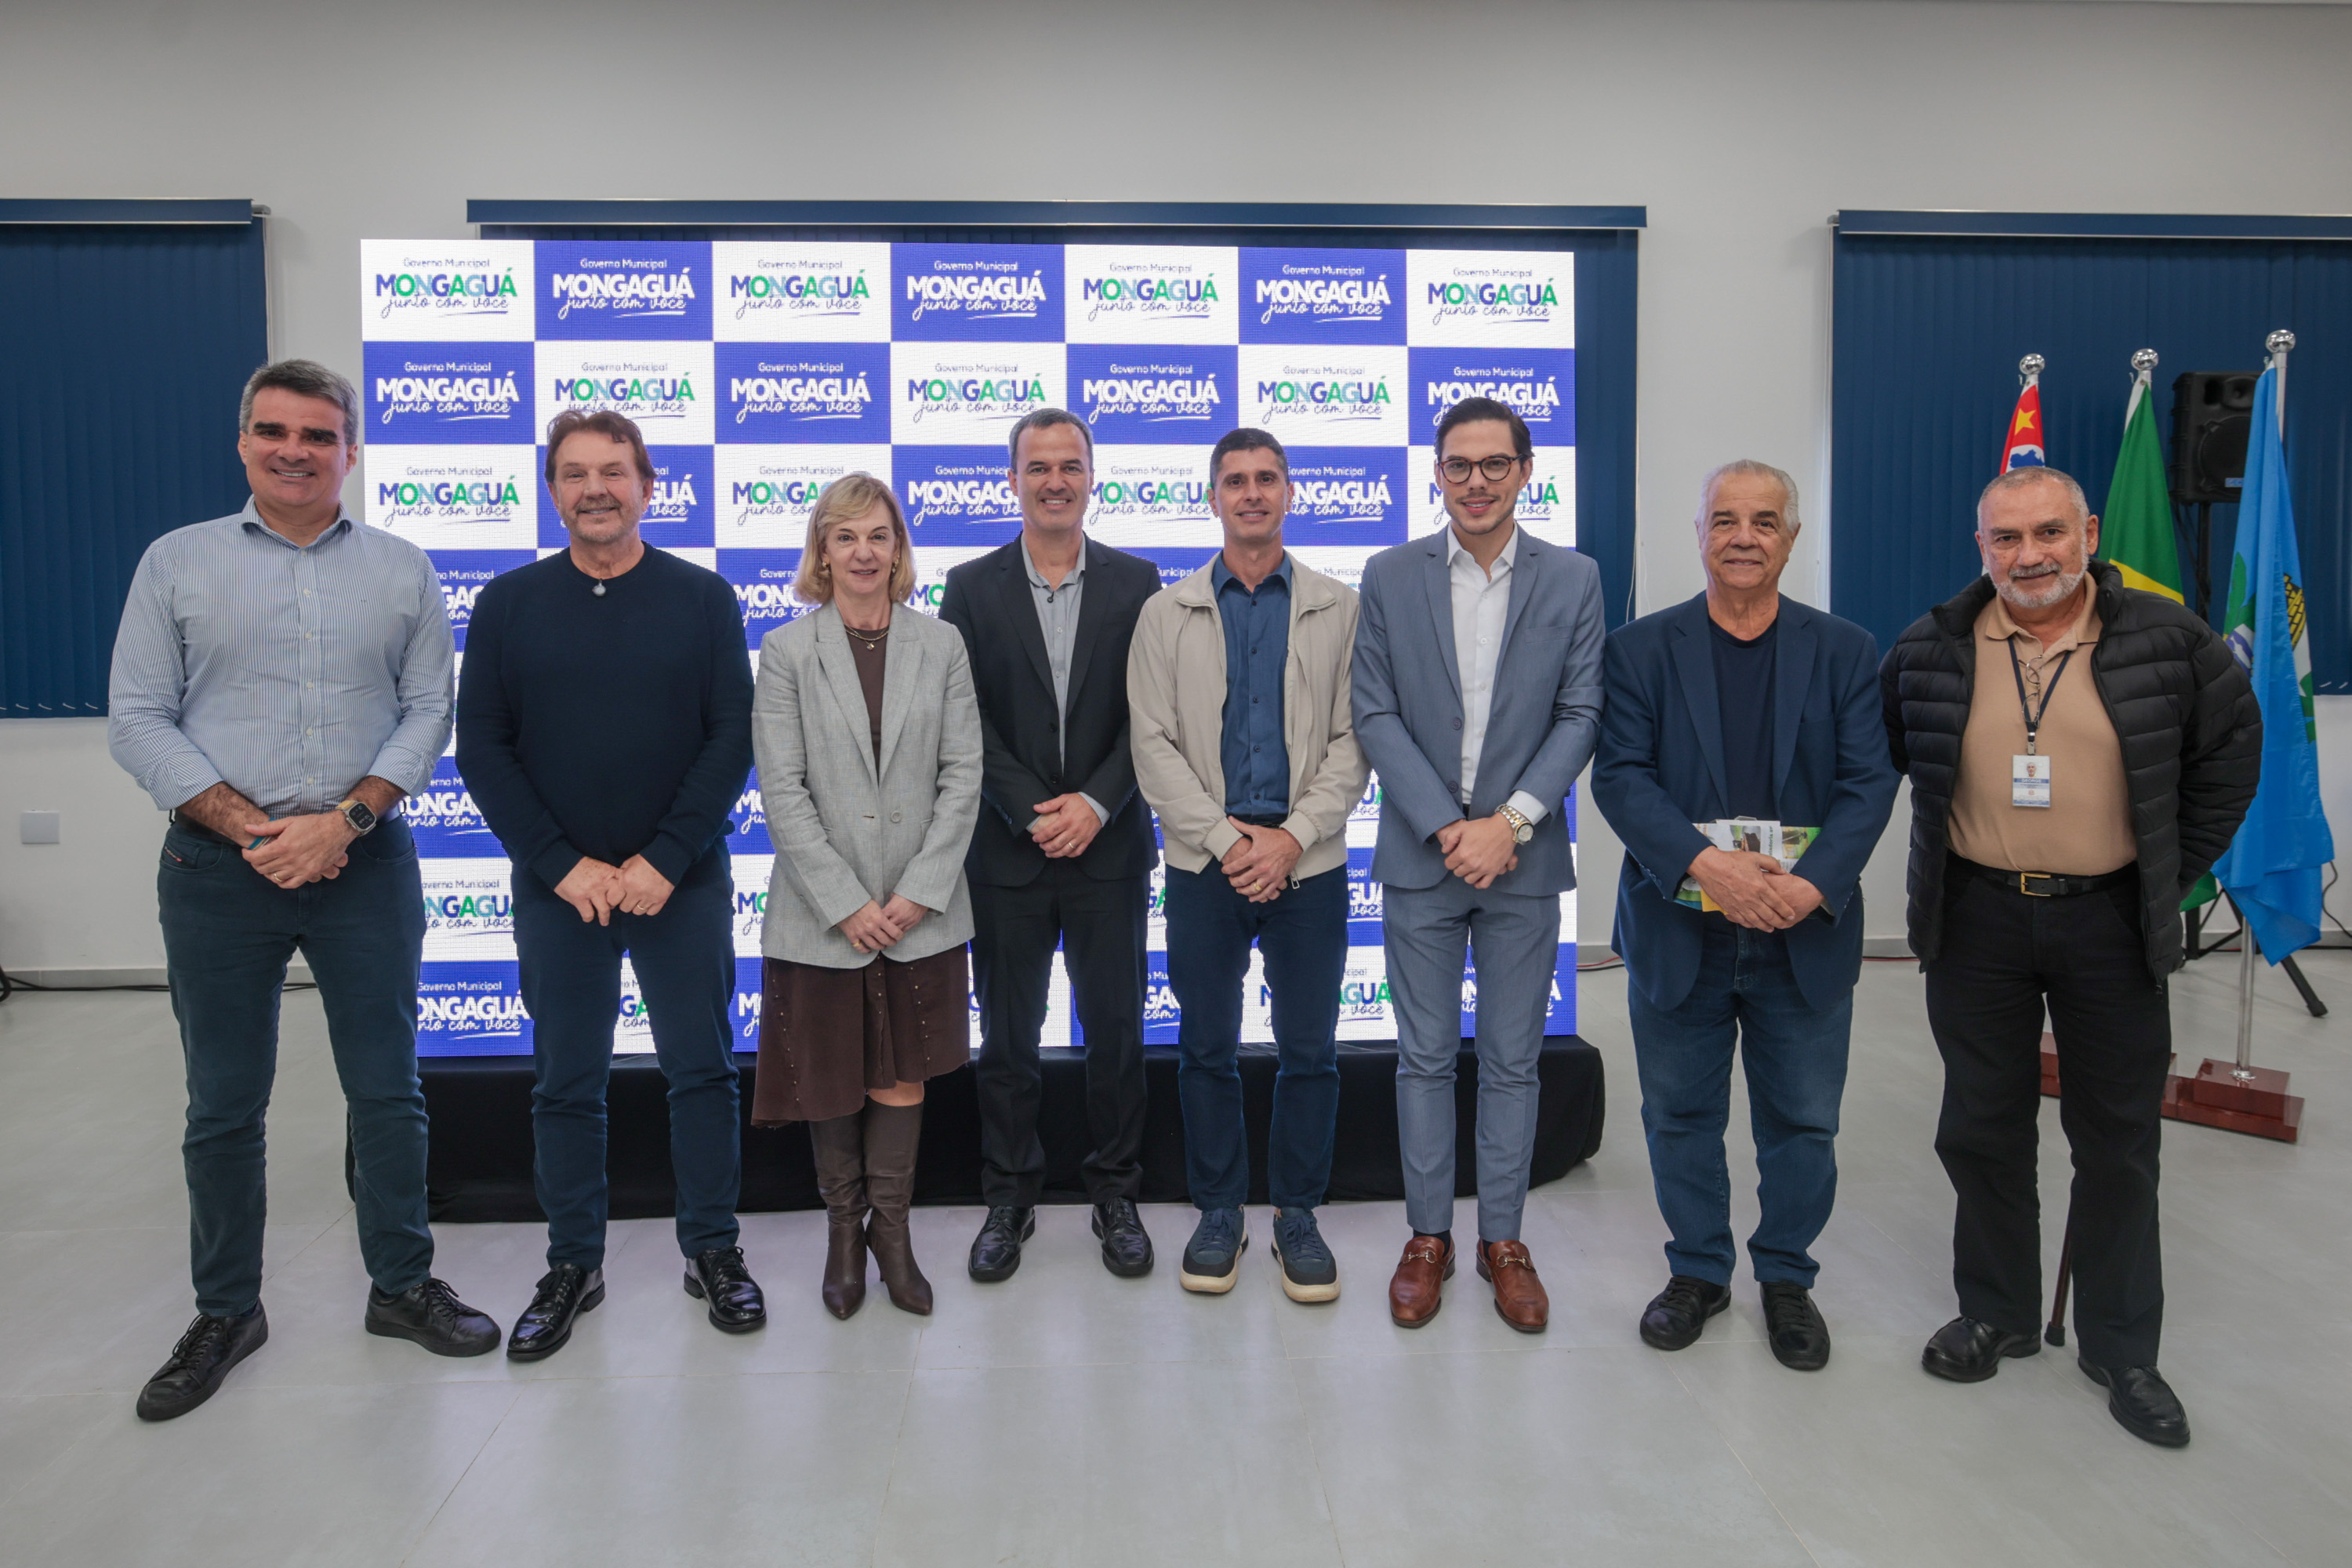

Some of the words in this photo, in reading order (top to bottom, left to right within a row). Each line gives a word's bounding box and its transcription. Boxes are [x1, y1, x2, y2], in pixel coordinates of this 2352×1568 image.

[403, 258, 442, 267] Governo
[445, 258, 488, 270] Municipal
[580, 258, 620, 268] Governo
[622, 259, 666, 270] Municipal
[758, 260, 797, 269] Governo
[800, 260, 842, 271] Municipal
[934, 260, 973, 270] Governo
[975, 261, 1018, 273] Municipal
[1109, 263, 1147, 272] Governo
[1150, 263, 1192, 274] Municipal
[1283, 265, 1320, 275] Governo
[1322, 265, 1364, 278] Municipal
[1454, 267, 1490, 277] Governo
[1493, 268, 1532, 280] Municipal
[376, 267, 517, 297] MONGAGUÁ
[553, 267, 695, 298] MONGAGUÁ
[731, 268, 869, 299] MONGAGUÁ
[907, 270, 1046, 300] MONGAGUÁ
[1083, 271, 1218, 301] MONGAGUÁ
[1257, 274, 1392, 304] MONGAGUÁ
[1428, 276, 1558, 306] MONGAGUÁ
[381, 292, 430, 318] junto
[436, 296, 466, 307] com
[473, 295, 508, 308] você
[558, 292, 608, 319] junto
[612, 297, 644, 308] com
[649, 295, 686, 309] você
[736, 293, 784, 320] junto
[789, 298, 819, 309] com
[826, 296, 861, 310] você
[913, 294, 960, 321] junto
[966, 299, 997, 310] com
[1002, 297, 1037, 310] você
[1088, 296, 1134, 321] junto
[1141, 300, 1170, 311] com
[1176, 299, 1210, 312] você
[1261, 297, 1308, 324] junto
[1313, 303, 1344, 313] com
[1348, 301, 1383, 314] você
[1432, 299, 1478, 325] junto
[1483, 305, 1511, 315] com
[1517, 303, 1550, 317] você
[405, 362, 445, 372] Governo
[446, 362, 491, 374] Municipal
[582, 362, 621, 371] Governo
[624, 362, 666, 373] Municipal
[758, 362, 797, 372] Governo
[799, 362, 843, 374] Municipal
[935, 363, 973, 372] Governo
[976, 364, 1018, 375] Municipal
[1109, 364, 1148, 374] Governo
[1149, 365, 1192, 376] Municipal
[1283, 366, 1320, 375] Governo
[1323, 366, 1364, 377] Municipal
[1454, 366, 1490, 376] Governo
[1492, 367, 1534, 379] Municipal
[377, 371, 520, 401] MONGAGUÁ
[555, 371, 694, 401] MONGAGUÁ
[731, 372, 871, 401] MONGAGUÁ
[909, 372, 1045, 401] MONGAGUÁ
[1083, 373, 1220, 403] MONGAGUÁ
[1258, 374, 1390, 404] MONGAGUÁ
[1428, 375, 1560, 405] MONGAGUÁ
[382, 396, 432, 424] junto
[437, 401, 470, 412] com
[474, 398, 510, 412] você
[614, 401, 644, 412] com
[651, 398, 686, 412] você
[736, 396, 785, 423] junto
[790, 401, 822, 412] com
[826, 398, 862, 412] você
[913, 397, 960, 423] junto
[967, 401, 996, 412] com
[1002, 399, 1036, 412] você
[1088, 397, 1136, 424] junto
[1141, 402, 1172, 413] com
[1176, 400, 1211, 413] você
[1262, 399, 1308, 424] junto
[1314, 403, 1342, 414] com
[1348, 401, 1382, 415] você
[1518, 402, 1552, 416] você
[407, 466, 445, 475] Governo
[448, 466, 492, 477] Municipal
[760, 466, 798, 474] Governo
[801, 466, 843, 477] Municipal
[935, 465, 974, 475] Governo
[1111, 466, 1149, 475] Governo
[1152, 466, 1192, 477] Municipal
[1323, 466, 1366, 477] Municipal
[379, 475, 520, 505] MONGAGUÁ
[733, 481, 833, 505] MONGA
[908, 481, 1019, 505] MONGAG
[1292, 474, 1392, 505] NGAGUÁ
[384, 501, 433, 528] junto
[439, 505, 469, 516] com
[475, 503, 511, 516] você
[652, 502, 688, 515] você
[738, 499, 785, 526] junto
[913, 499, 962, 526] junto
[967, 504, 998, 514] com
[1089, 499, 1136, 525] junto
[1142, 504, 1171, 514] com
[1315, 504, 1345, 514] com
[1349, 502, 1384, 515] você
[1518, 503, 1551, 515] você
[449, 570, 495, 581] Municipal
[444, 815, 477, 827] com
[456, 880, 499, 890] Municipal
[424, 895, 514, 918] NGAGU
[447, 919, 477, 929] com
[457, 981, 502, 993] Municipal
[417, 989, 532, 1021] ONGAGUÁ
[448, 1019, 481, 1031] com
[485, 1018, 522, 1031] você
